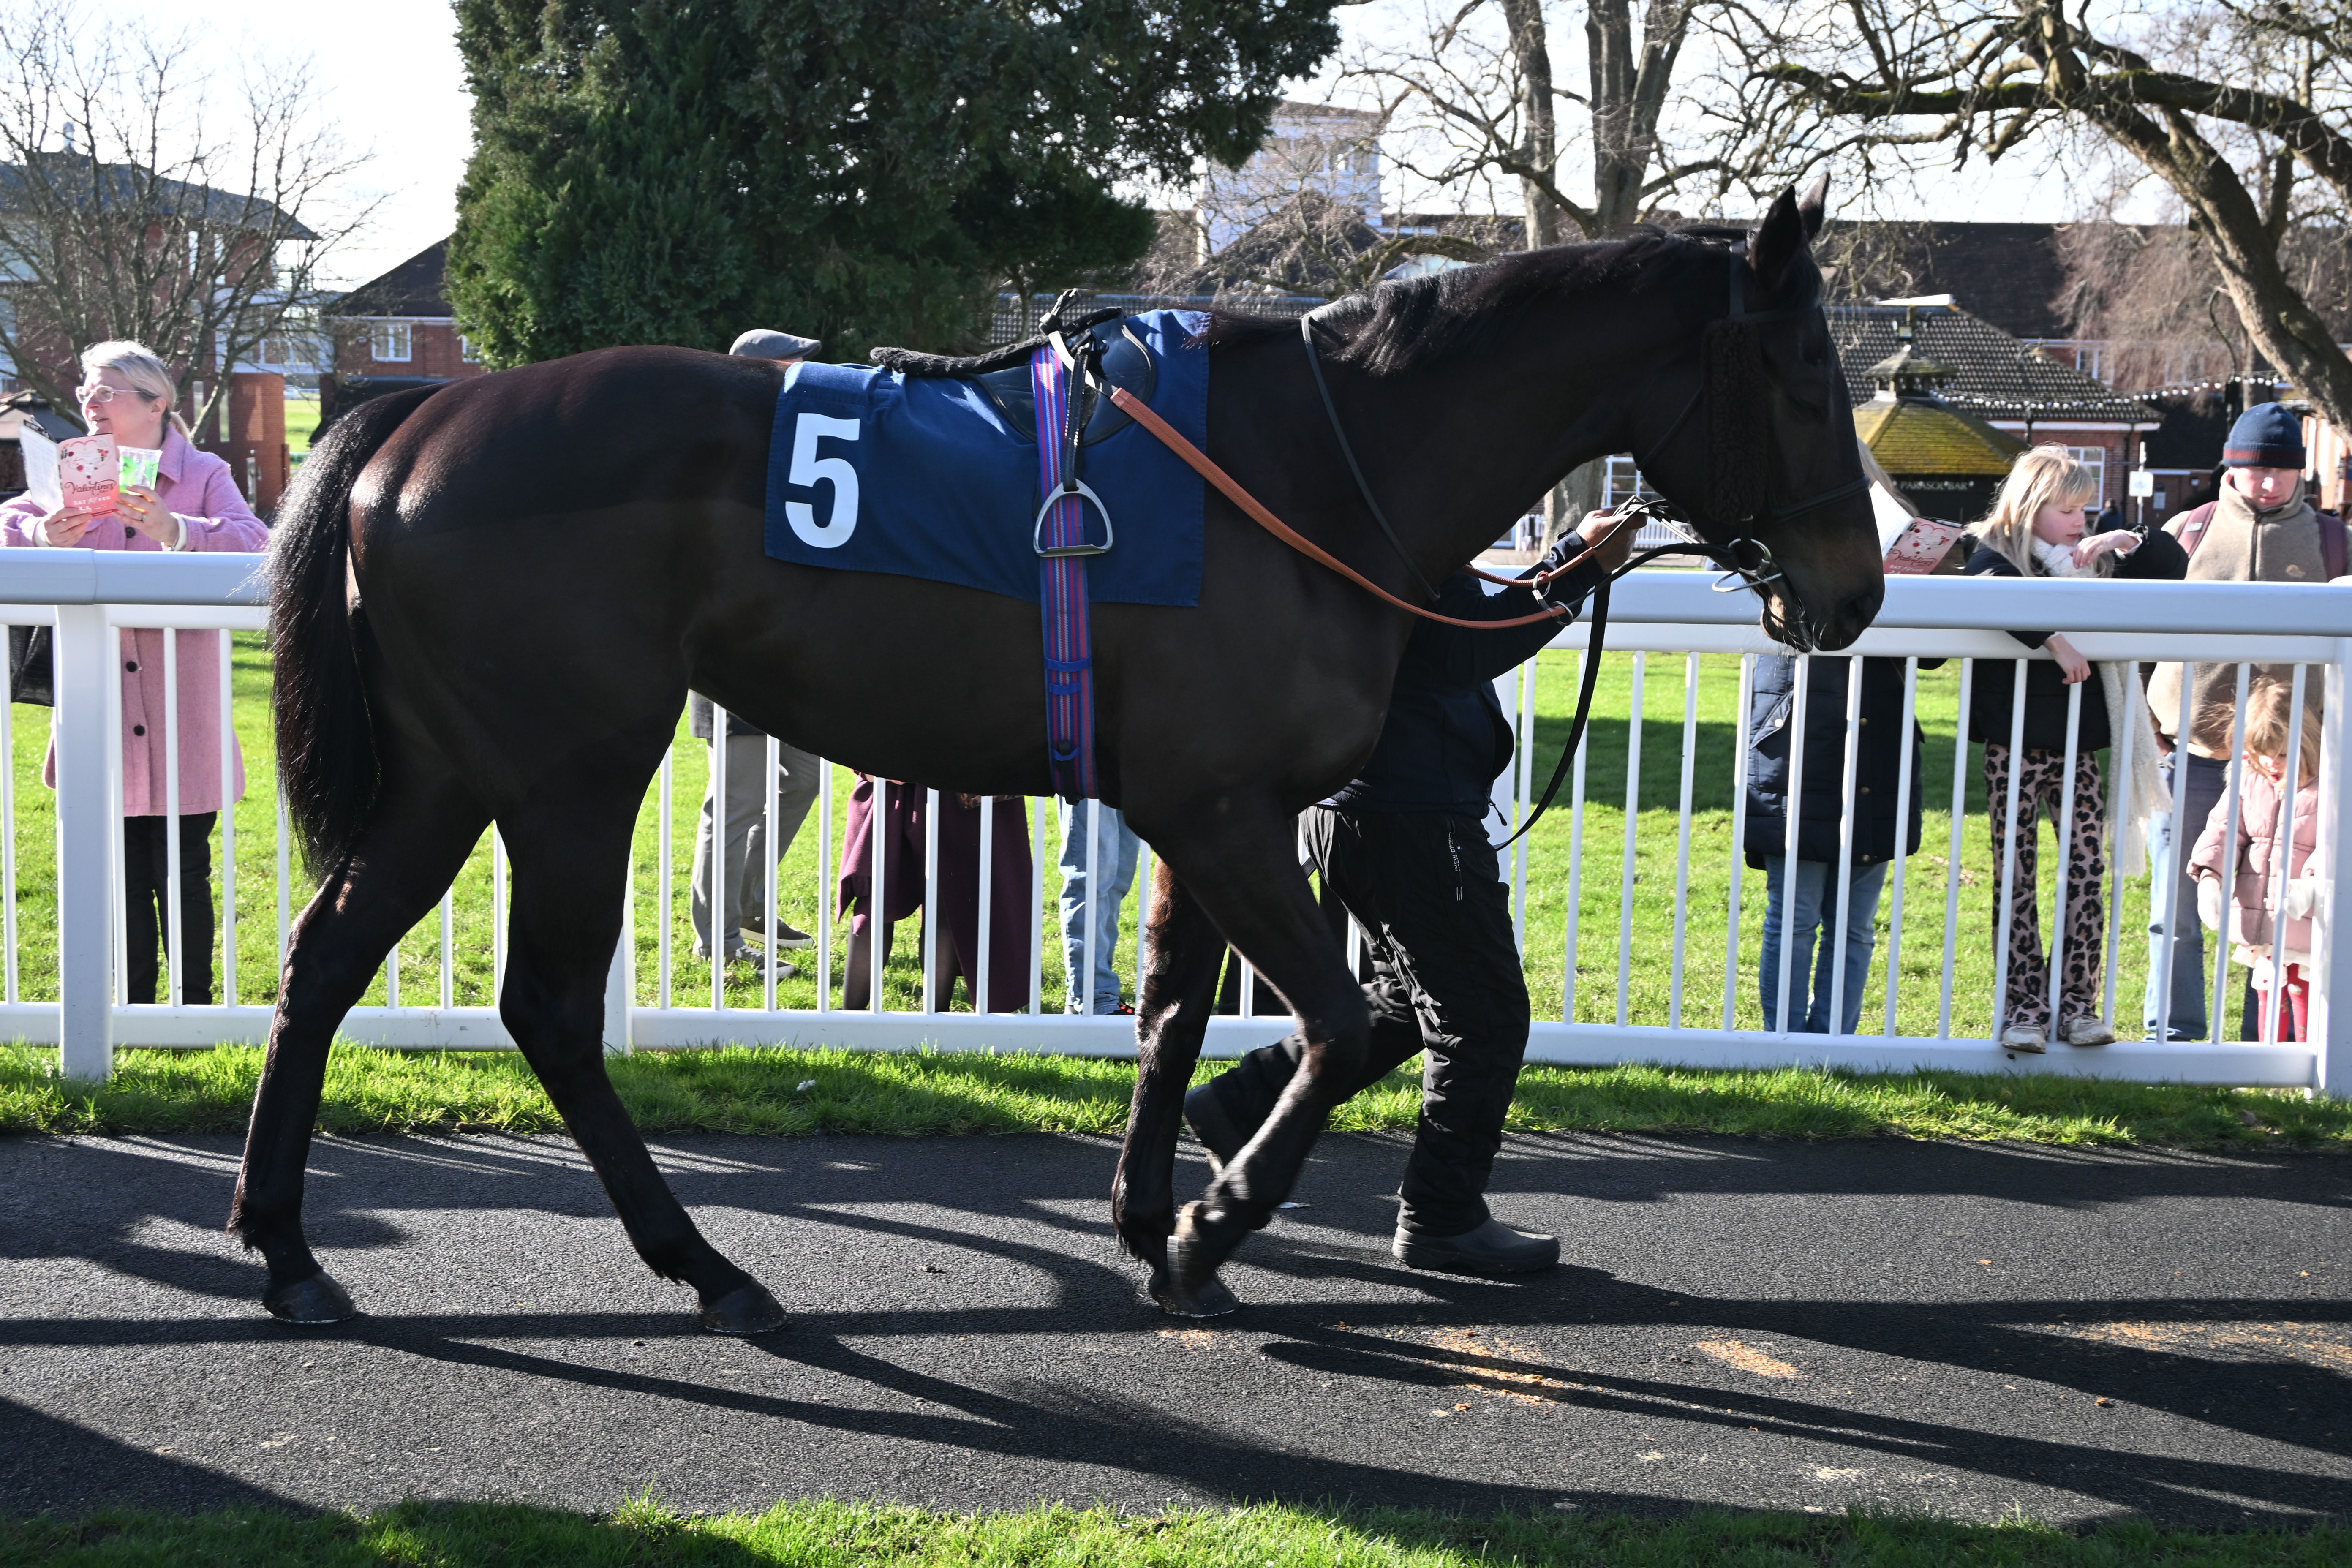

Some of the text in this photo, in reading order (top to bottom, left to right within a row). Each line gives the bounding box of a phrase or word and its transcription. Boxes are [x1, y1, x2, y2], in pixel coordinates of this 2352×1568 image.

[785, 413, 860, 548] 5
[1900, 481, 1968, 491] PARASOL BAR
